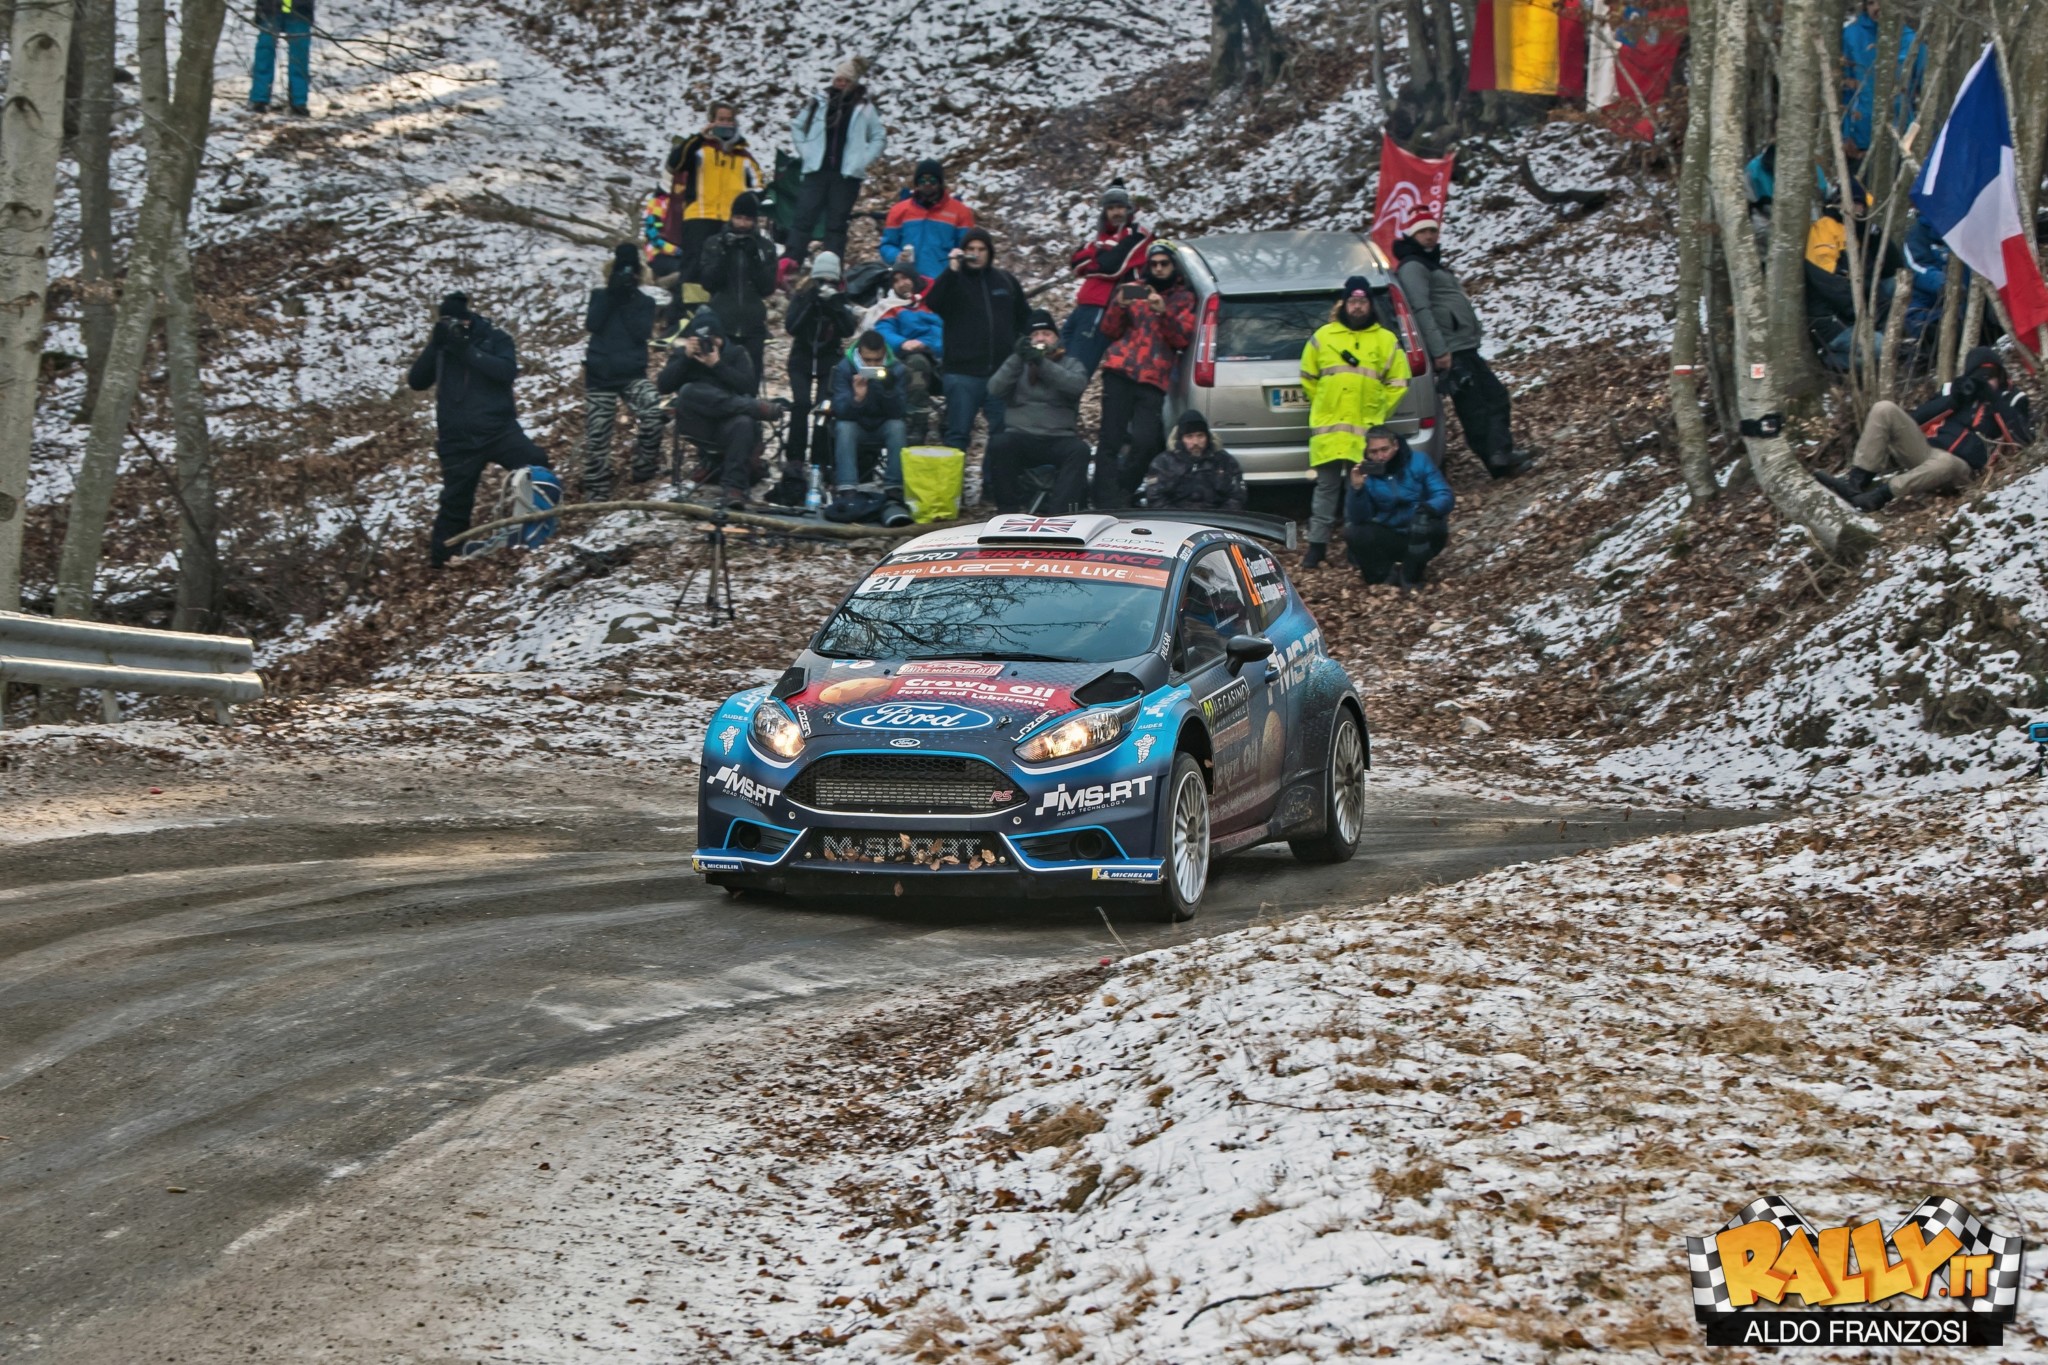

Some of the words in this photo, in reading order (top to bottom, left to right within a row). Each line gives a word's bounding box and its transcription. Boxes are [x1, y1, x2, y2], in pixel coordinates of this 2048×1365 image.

[887, 551, 958, 565] FORD
[958, 549, 1164, 567] PERFORMANCE
[1035, 564, 1073, 574] ALL
[1080, 566, 1128, 579] LIVE
[868, 577, 899, 591] 21
[1160, 632, 1172, 661] PULSAR
[905, 678, 998, 692] Crown
[1009, 685, 1056, 698] Oil
[971, 693, 1046, 707] Lubricants
[722, 713, 749, 722] AUDES
[861, 704, 967, 728] Ford
[1138, 722, 1163, 730] AUDES
[724, 770, 781, 807] MS-RT
[989, 790, 1014, 802] RS
[1056, 775, 1153, 812] MS-RT
[1056, 809, 1076, 817] ROAD
[1079, 799, 1127, 814] TECHNOLOGY
